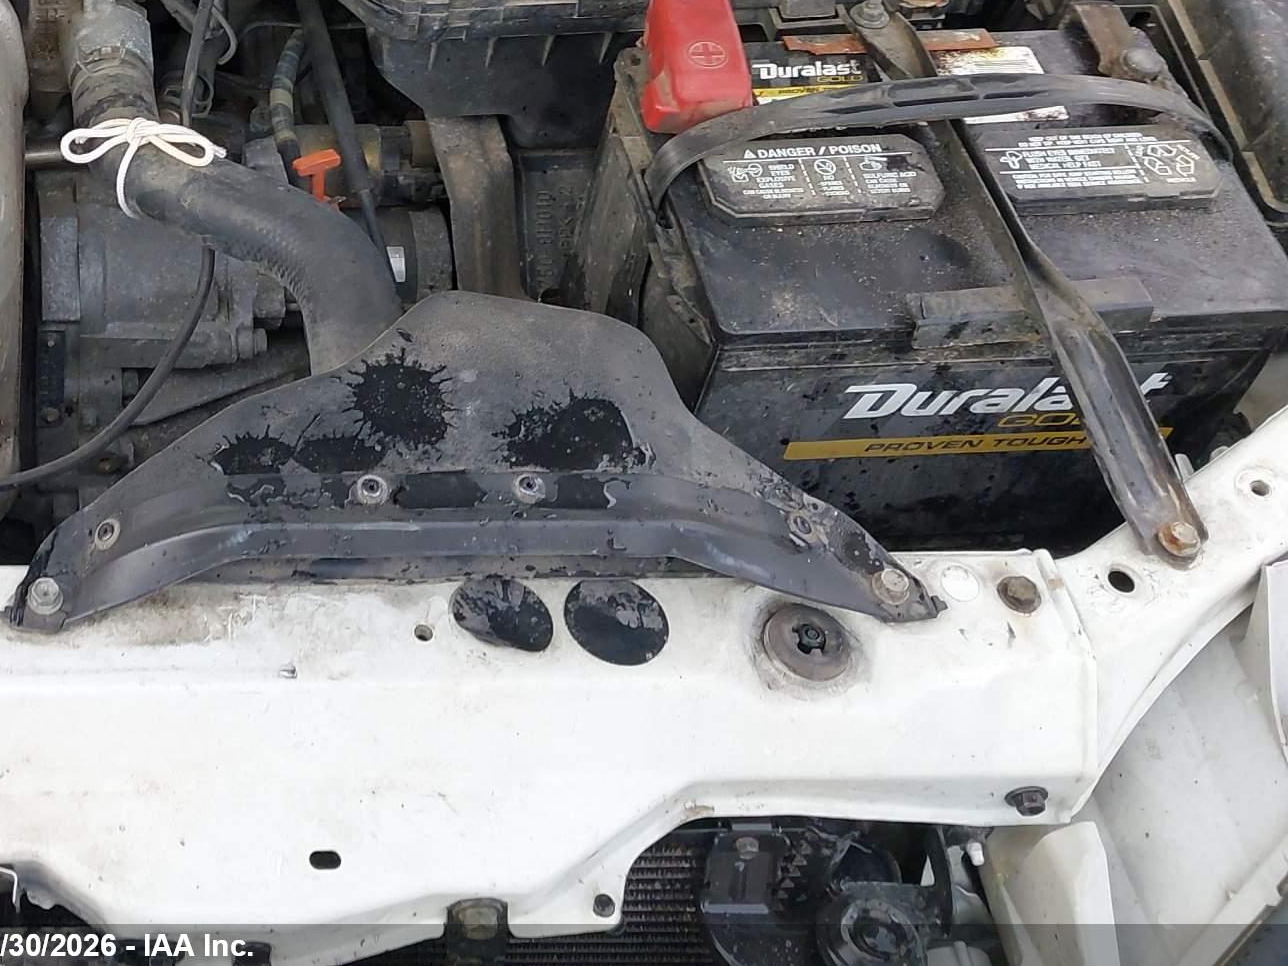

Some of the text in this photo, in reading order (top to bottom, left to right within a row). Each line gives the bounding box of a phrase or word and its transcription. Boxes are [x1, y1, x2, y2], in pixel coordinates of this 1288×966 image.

[752, 59, 863, 80] Duralast
[816, 75, 864, 84] GOLD
[757, 143, 882, 159] DANGER / POISON
[843, 372, 1174, 420] Duralat
[864, 435, 1087, 453] PROVEN TOUGH
